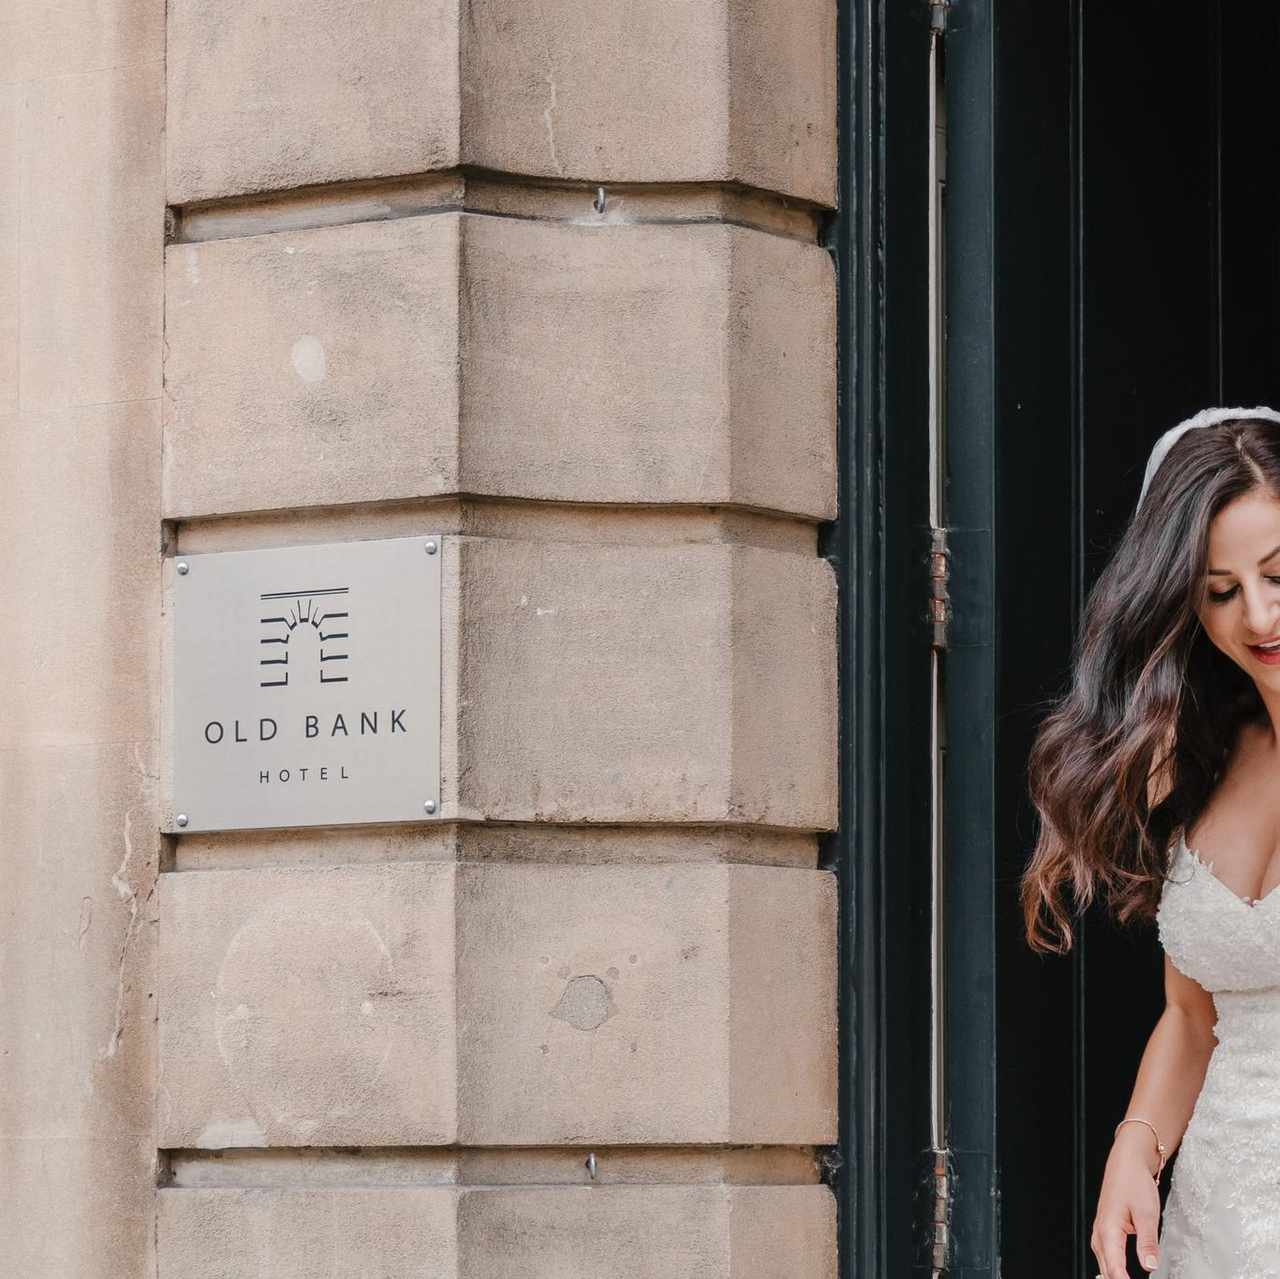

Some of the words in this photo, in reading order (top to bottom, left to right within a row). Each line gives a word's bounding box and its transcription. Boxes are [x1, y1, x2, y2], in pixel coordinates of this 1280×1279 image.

[204, 718, 278, 744] OLD
[305, 709, 407, 739] BANK
[259, 766, 349, 784] HOTEL
